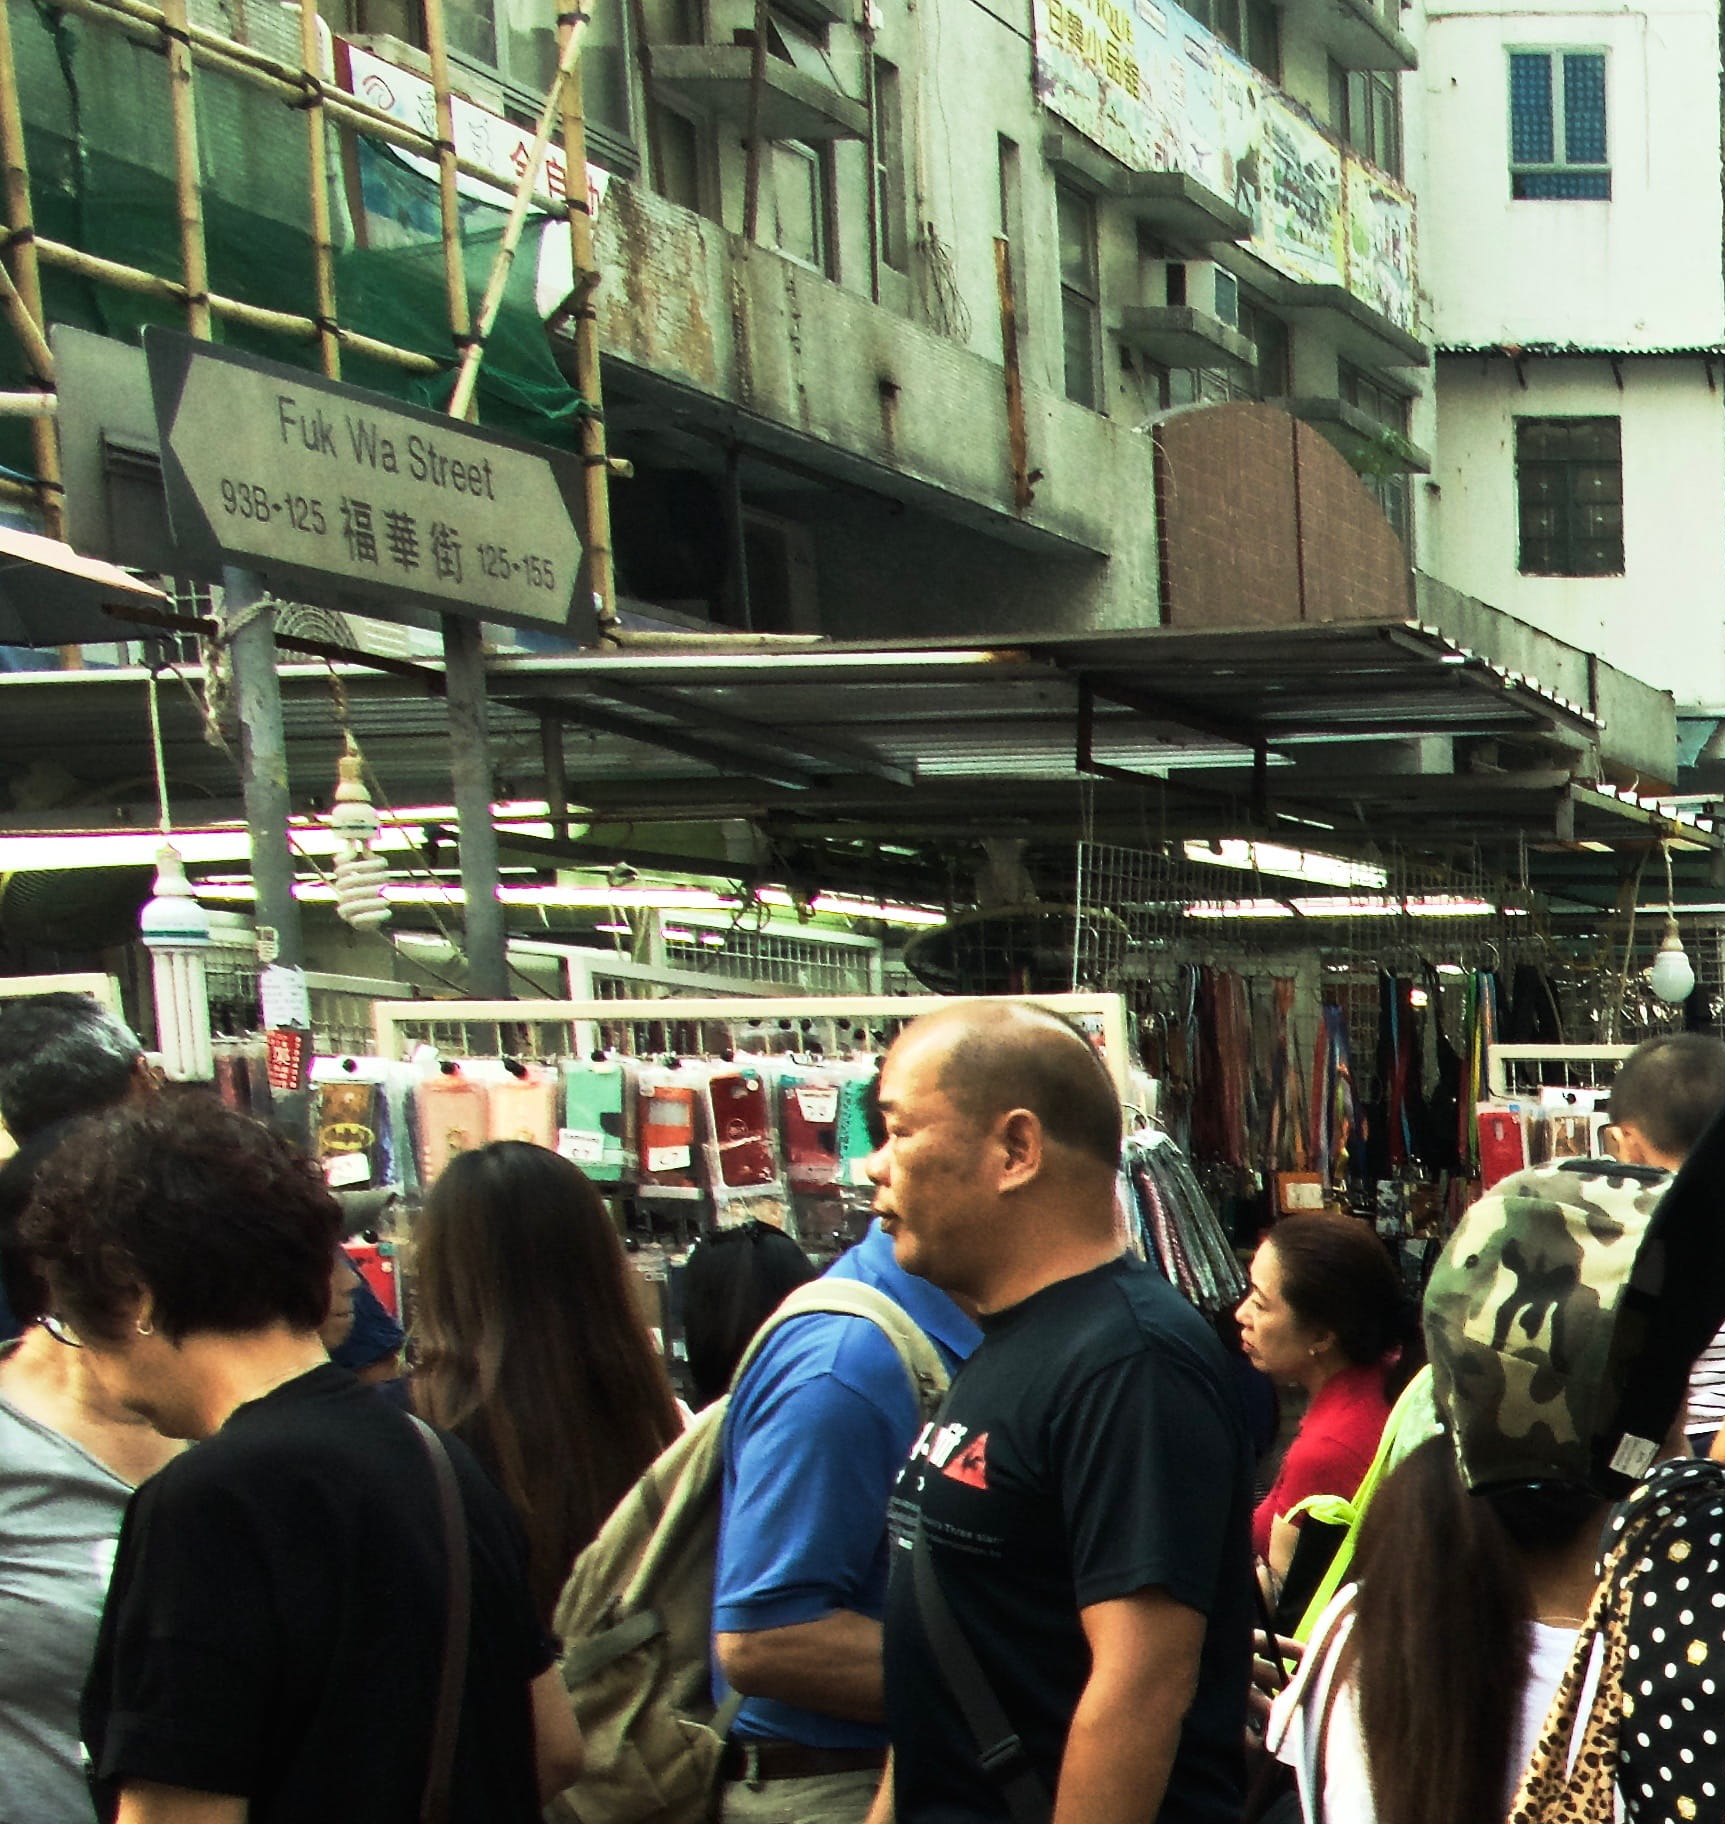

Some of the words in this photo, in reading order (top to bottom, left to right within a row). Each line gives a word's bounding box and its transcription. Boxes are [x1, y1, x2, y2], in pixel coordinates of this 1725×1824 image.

[277, 395, 338, 458] Fuk
[346, 414, 399, 475] Wa
[408, 434, 496, 501] Street
[220, 478, 328, 536] 93B-125
[340, 495, 463, 585] 福華街
[477, 543, 556, 591] 125-155
